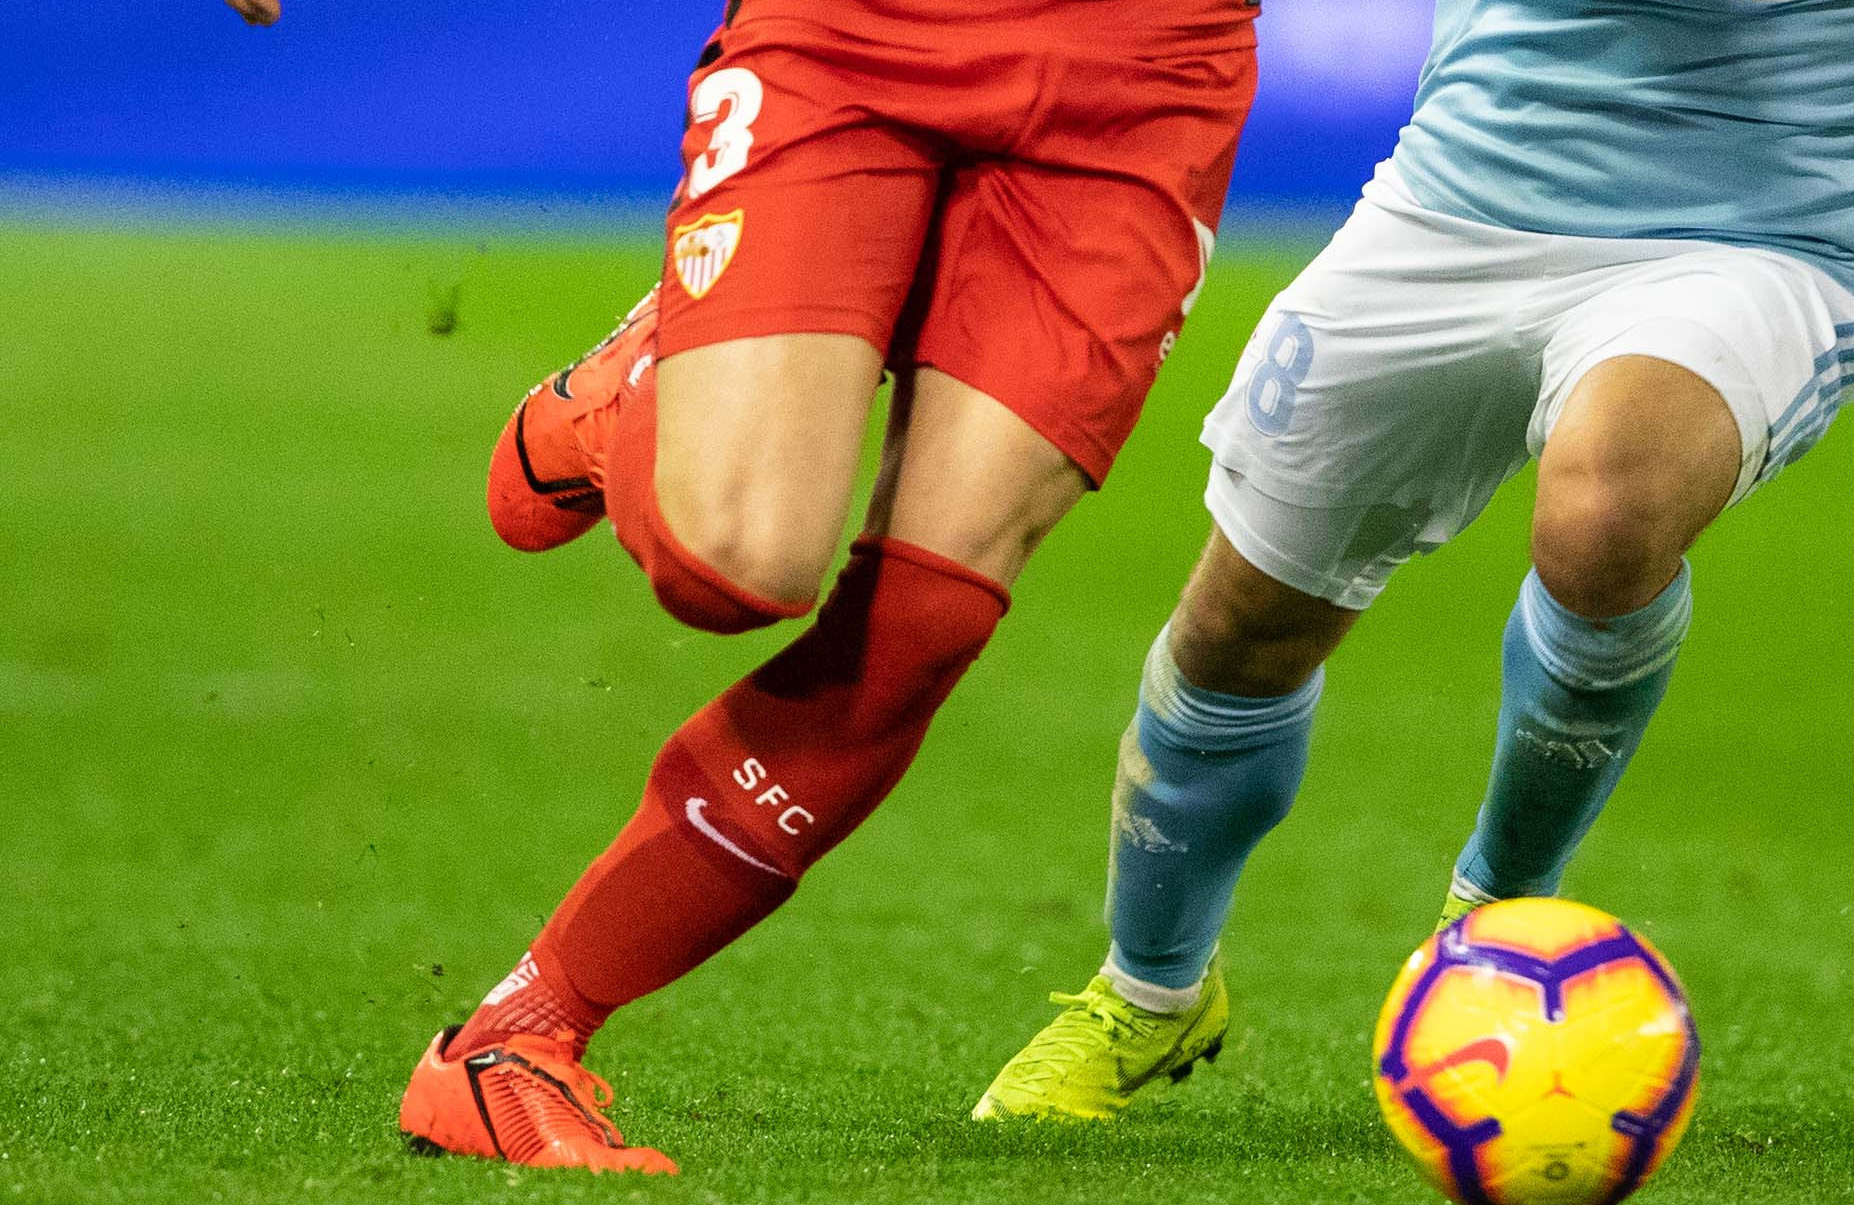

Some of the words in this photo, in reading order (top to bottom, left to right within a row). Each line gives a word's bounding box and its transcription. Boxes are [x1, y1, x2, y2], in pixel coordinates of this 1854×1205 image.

[688, 67, 764, 200] 3
[1246, 311, 1314, 436] 8
[733, 757, 815, 835] SFC
